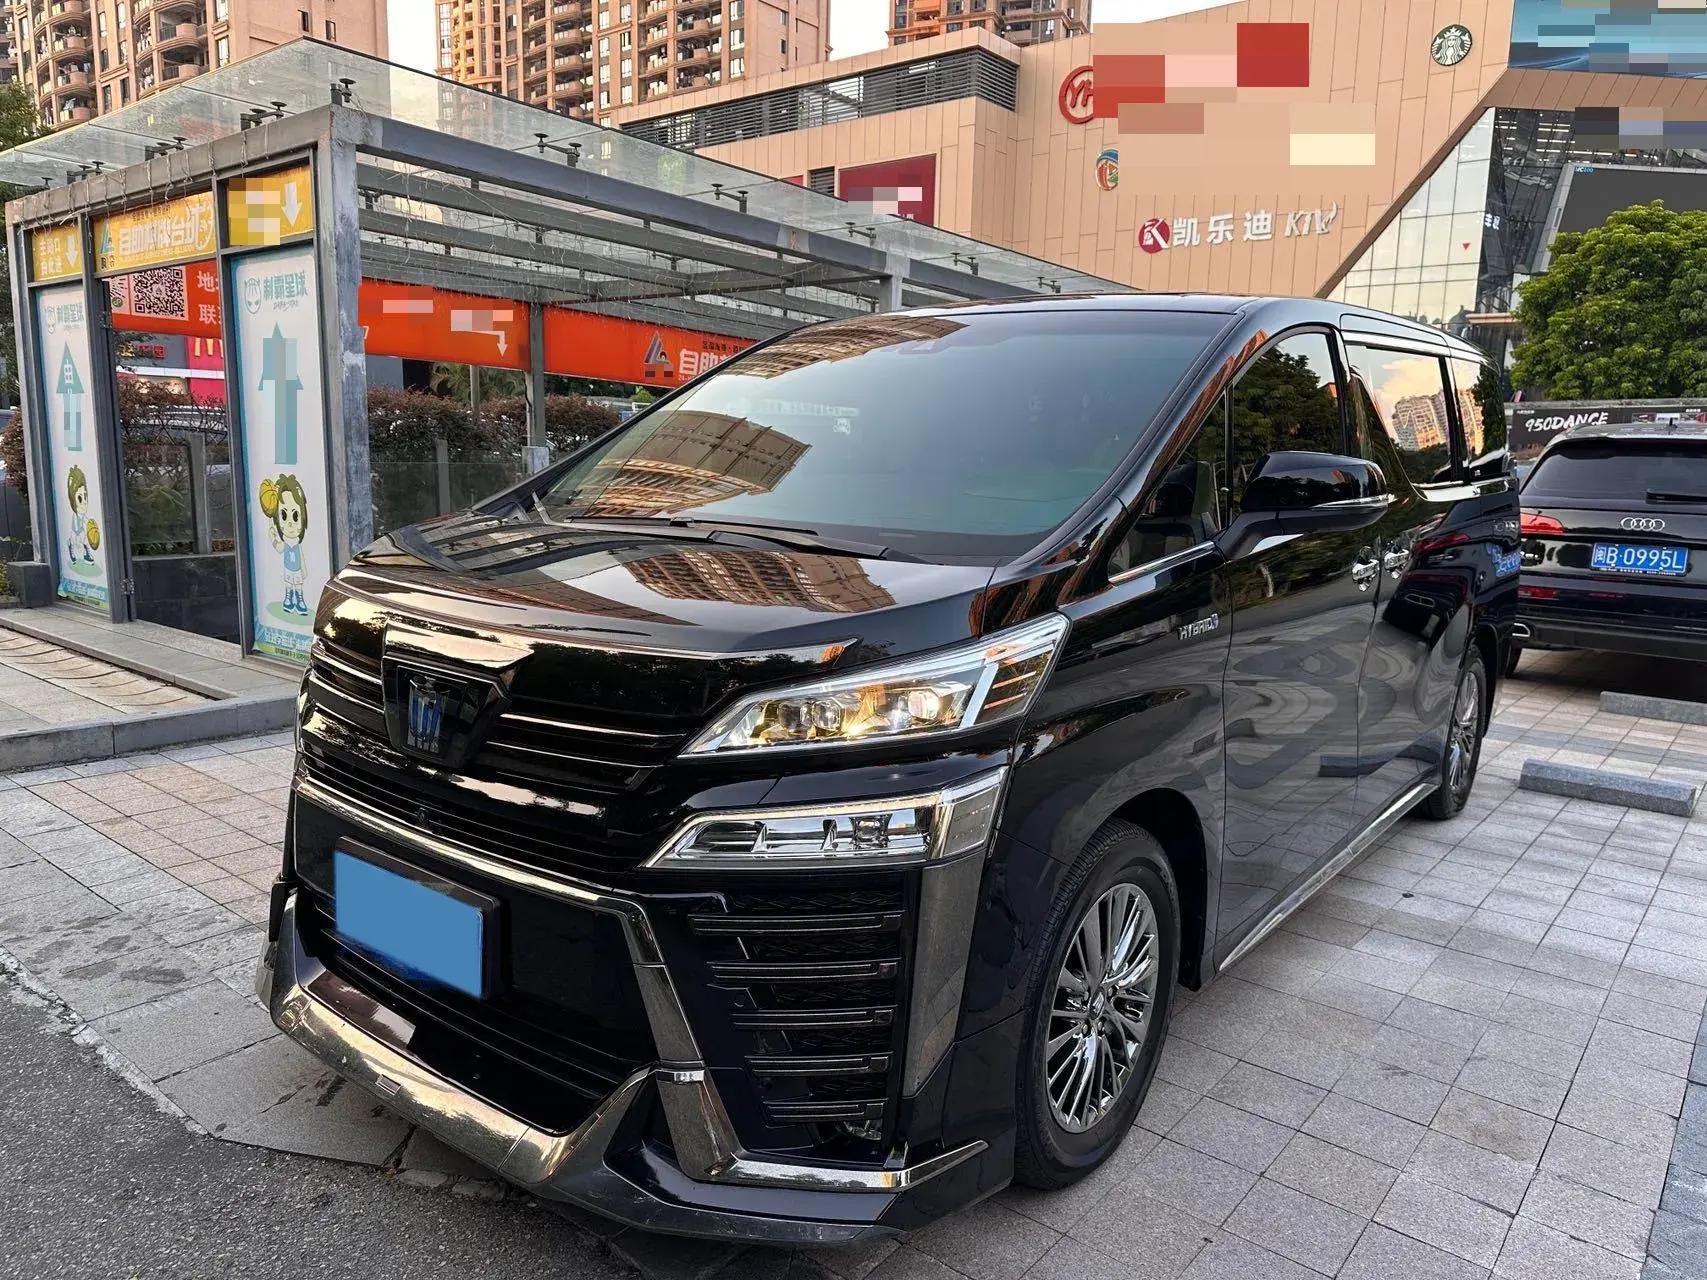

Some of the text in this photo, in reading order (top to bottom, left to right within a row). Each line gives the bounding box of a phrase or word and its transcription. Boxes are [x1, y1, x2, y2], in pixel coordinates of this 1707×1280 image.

[1172, 201, 1337, 247] 凯乐迪 KTV
